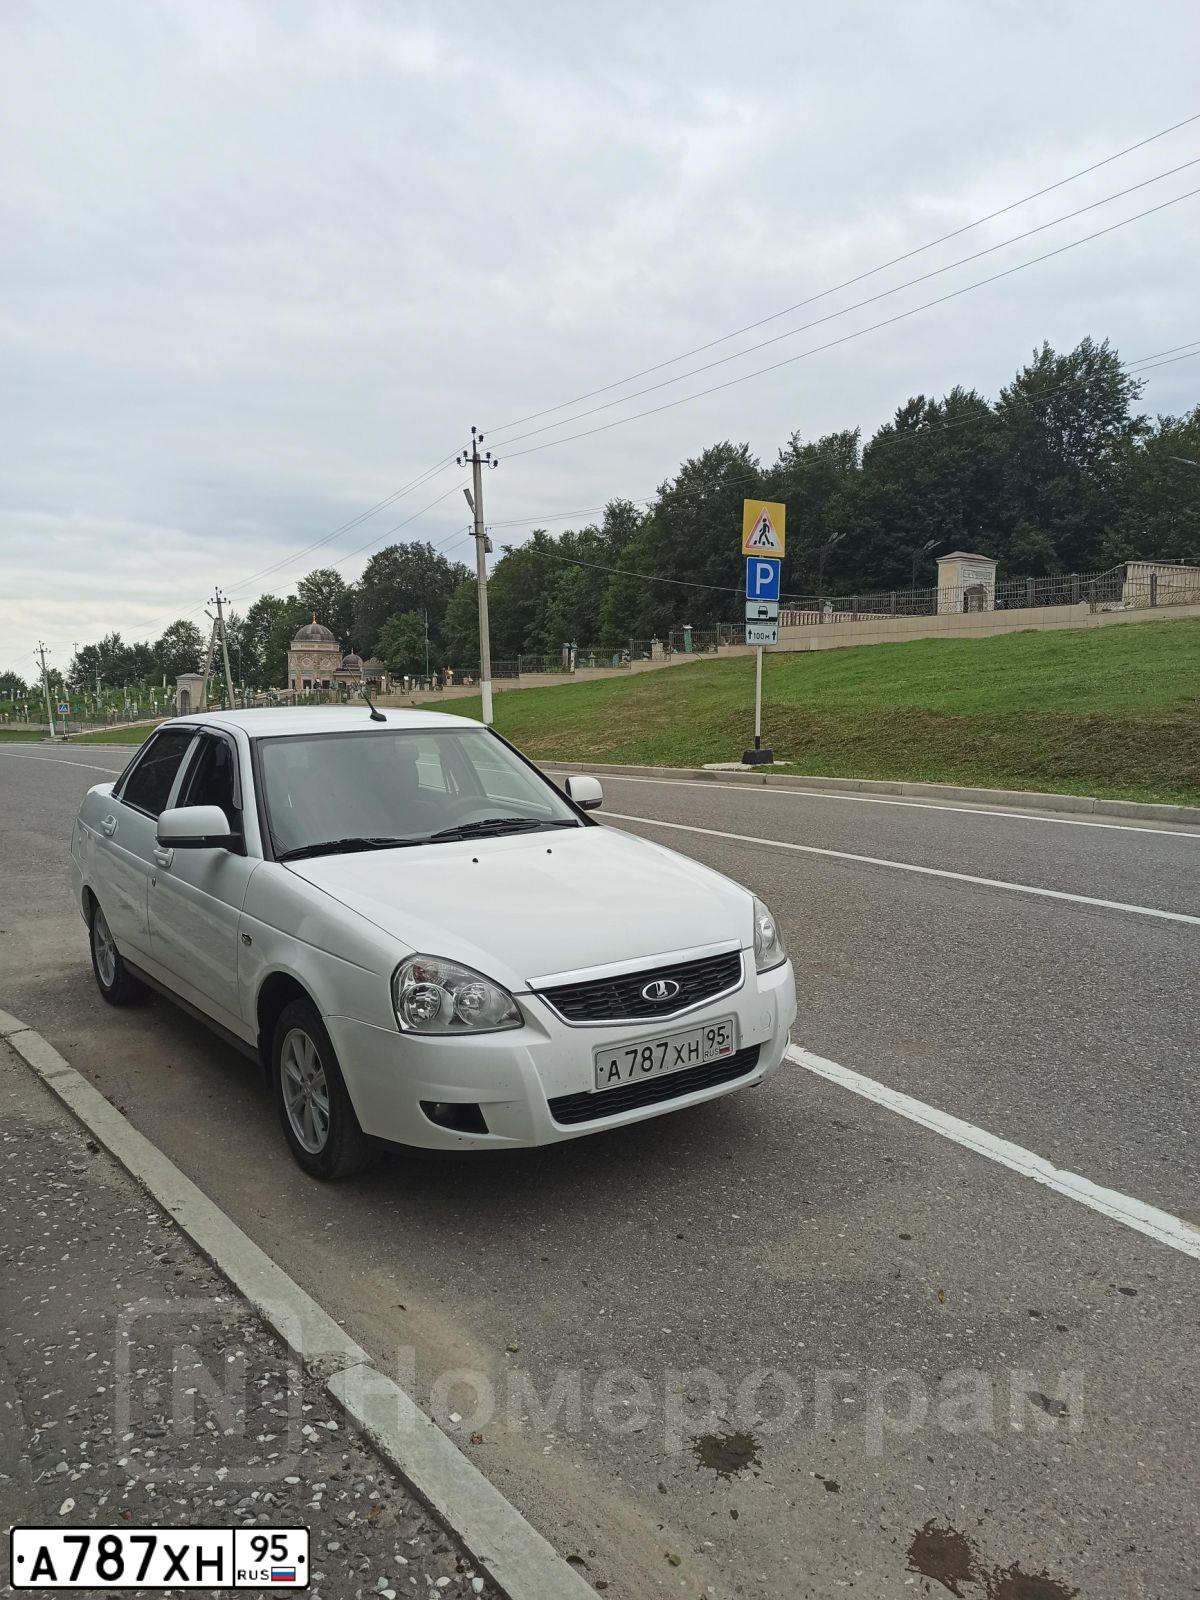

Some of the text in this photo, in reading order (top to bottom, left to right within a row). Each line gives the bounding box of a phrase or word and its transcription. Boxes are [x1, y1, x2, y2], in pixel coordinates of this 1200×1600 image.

[755, 562, 774, 595] P
[706, 1026, 726, 1048] 95
[704, 1049, 719, 1058] RUS
